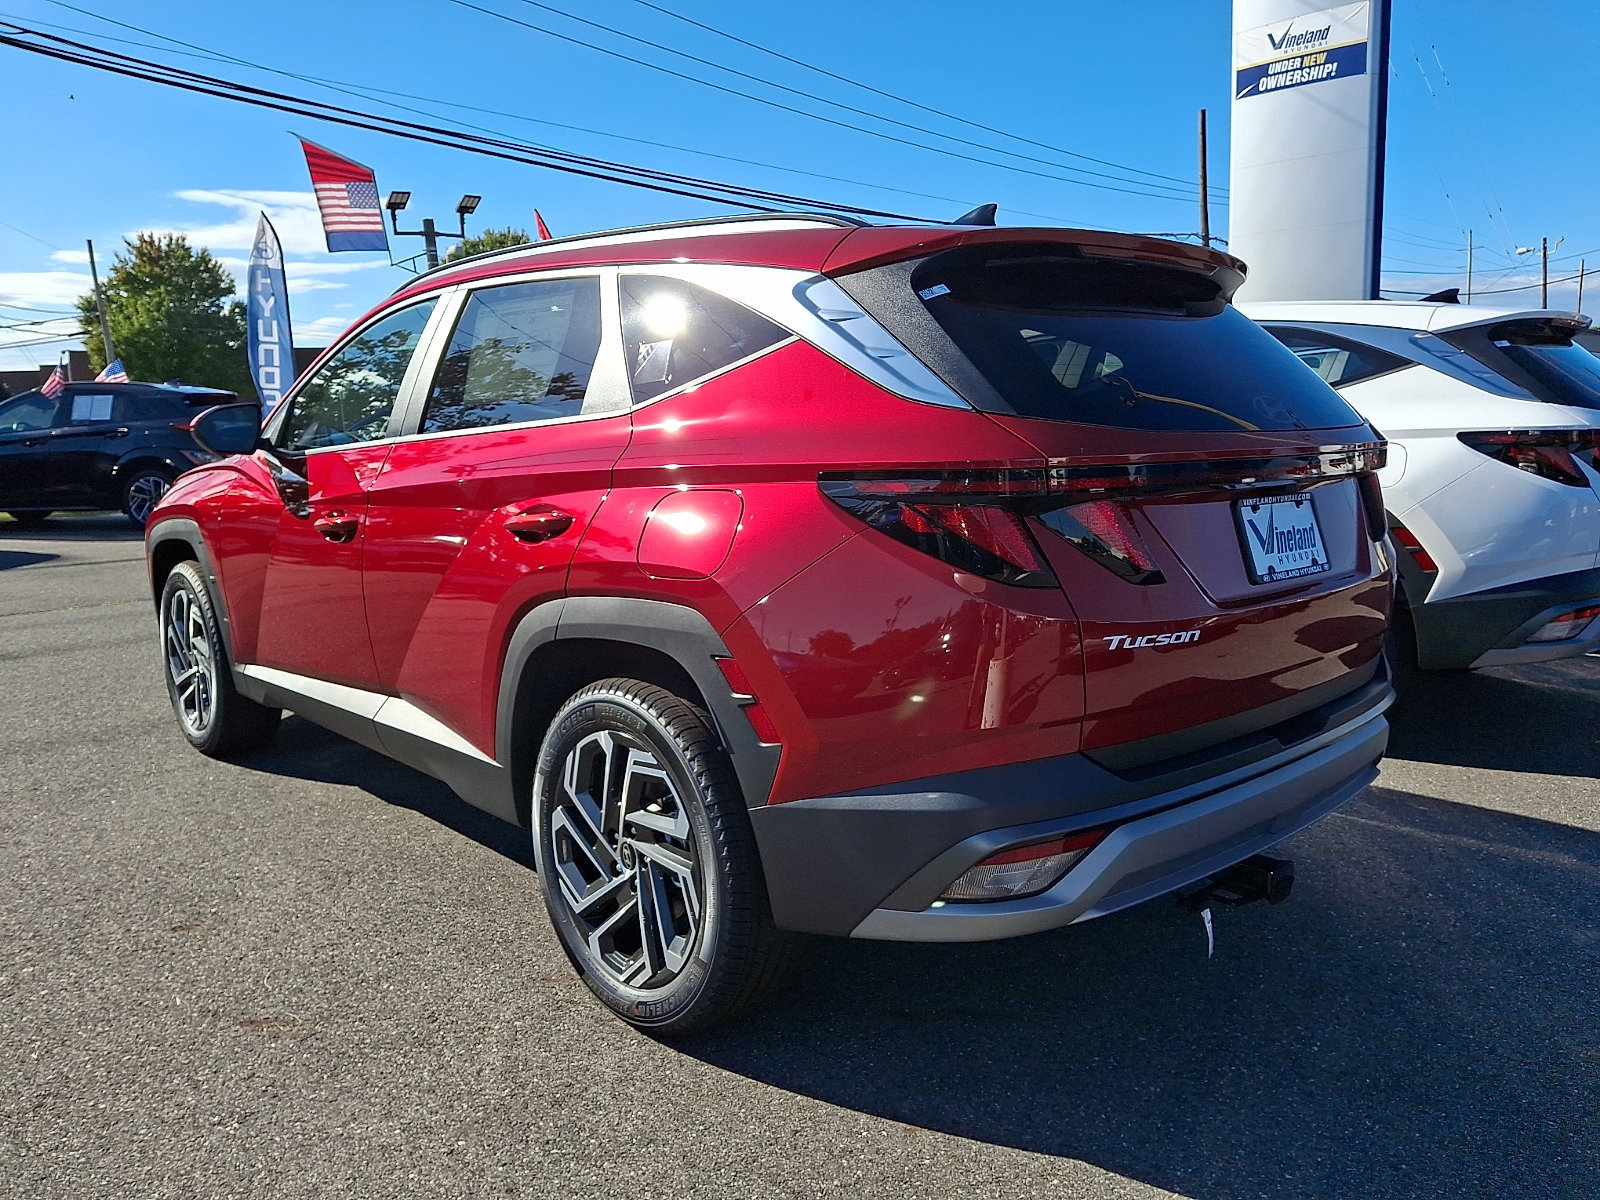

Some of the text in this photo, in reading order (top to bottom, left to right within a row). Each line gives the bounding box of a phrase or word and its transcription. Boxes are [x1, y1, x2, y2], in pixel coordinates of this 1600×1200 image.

[1267, 21, 1332, 50] Vineland
[1284, 41, 1328, 54] HYUNDAI
[1268, 52, 1328, 75] UNDER NEW
[1258, 62, 1338, 92] OWNERSHIP!
[1246, 504, 1317, 556] Vineland
[1277, 549, 1320, 565] HYUNDAI
[1272, 565, 1322, 581] VINELAND HYUNDAI
